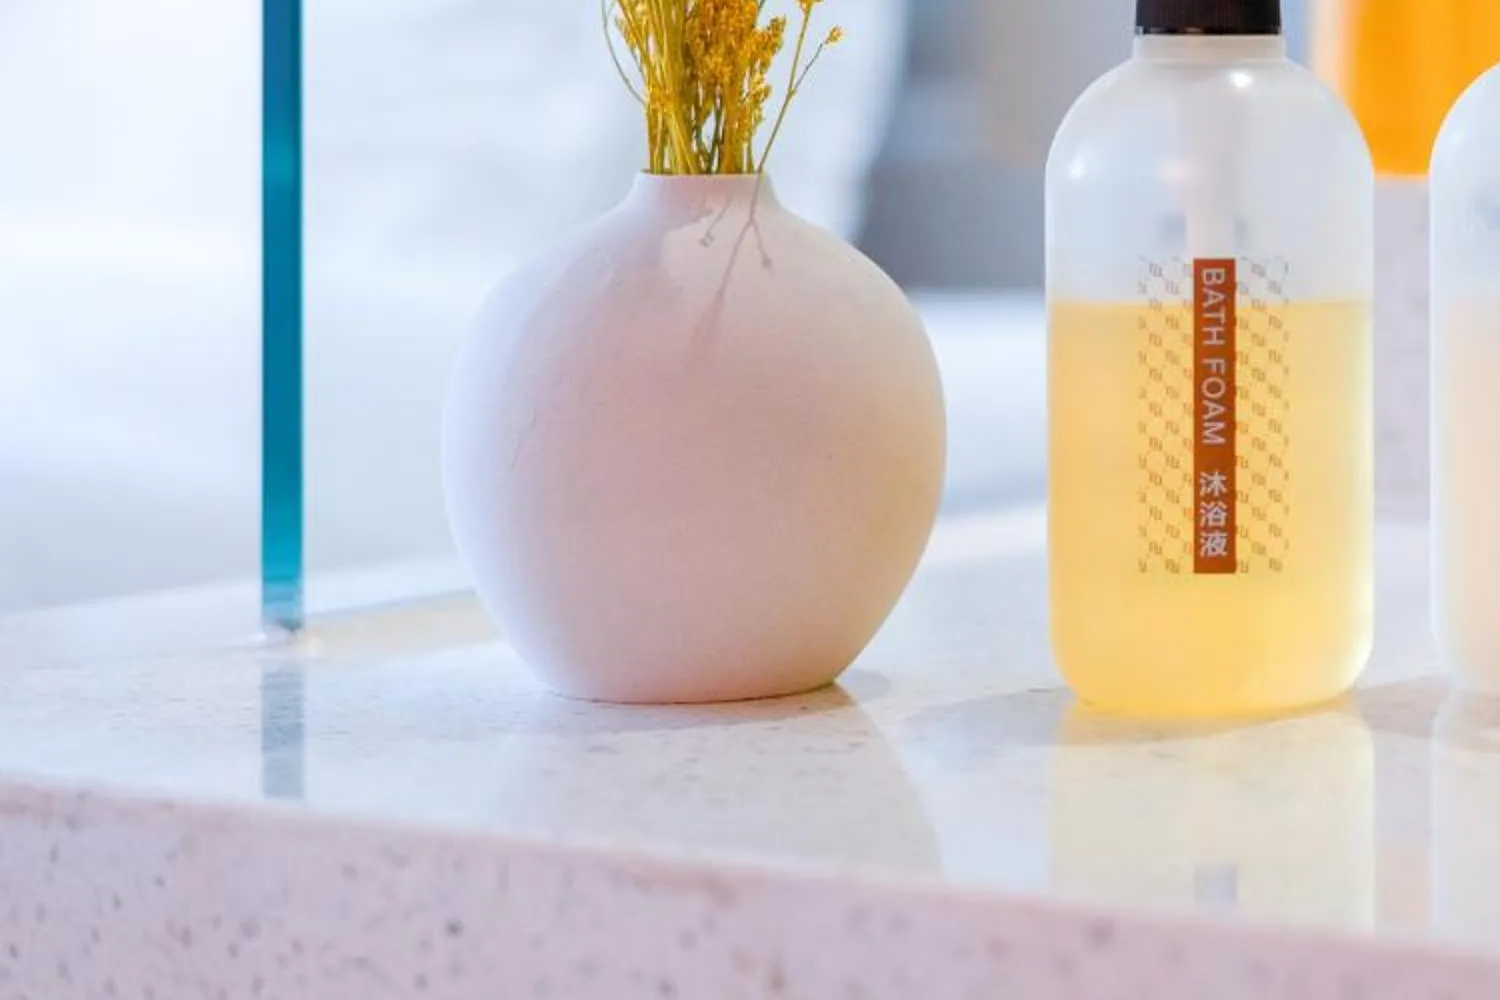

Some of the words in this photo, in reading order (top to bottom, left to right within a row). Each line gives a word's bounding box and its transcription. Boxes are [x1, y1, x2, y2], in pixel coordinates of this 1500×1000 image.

[1201, 268, 1226, 346] BATH
[1201, 358, 1227, 445] FOAM
[1199, 470, 1227, 558] 沐浴液
